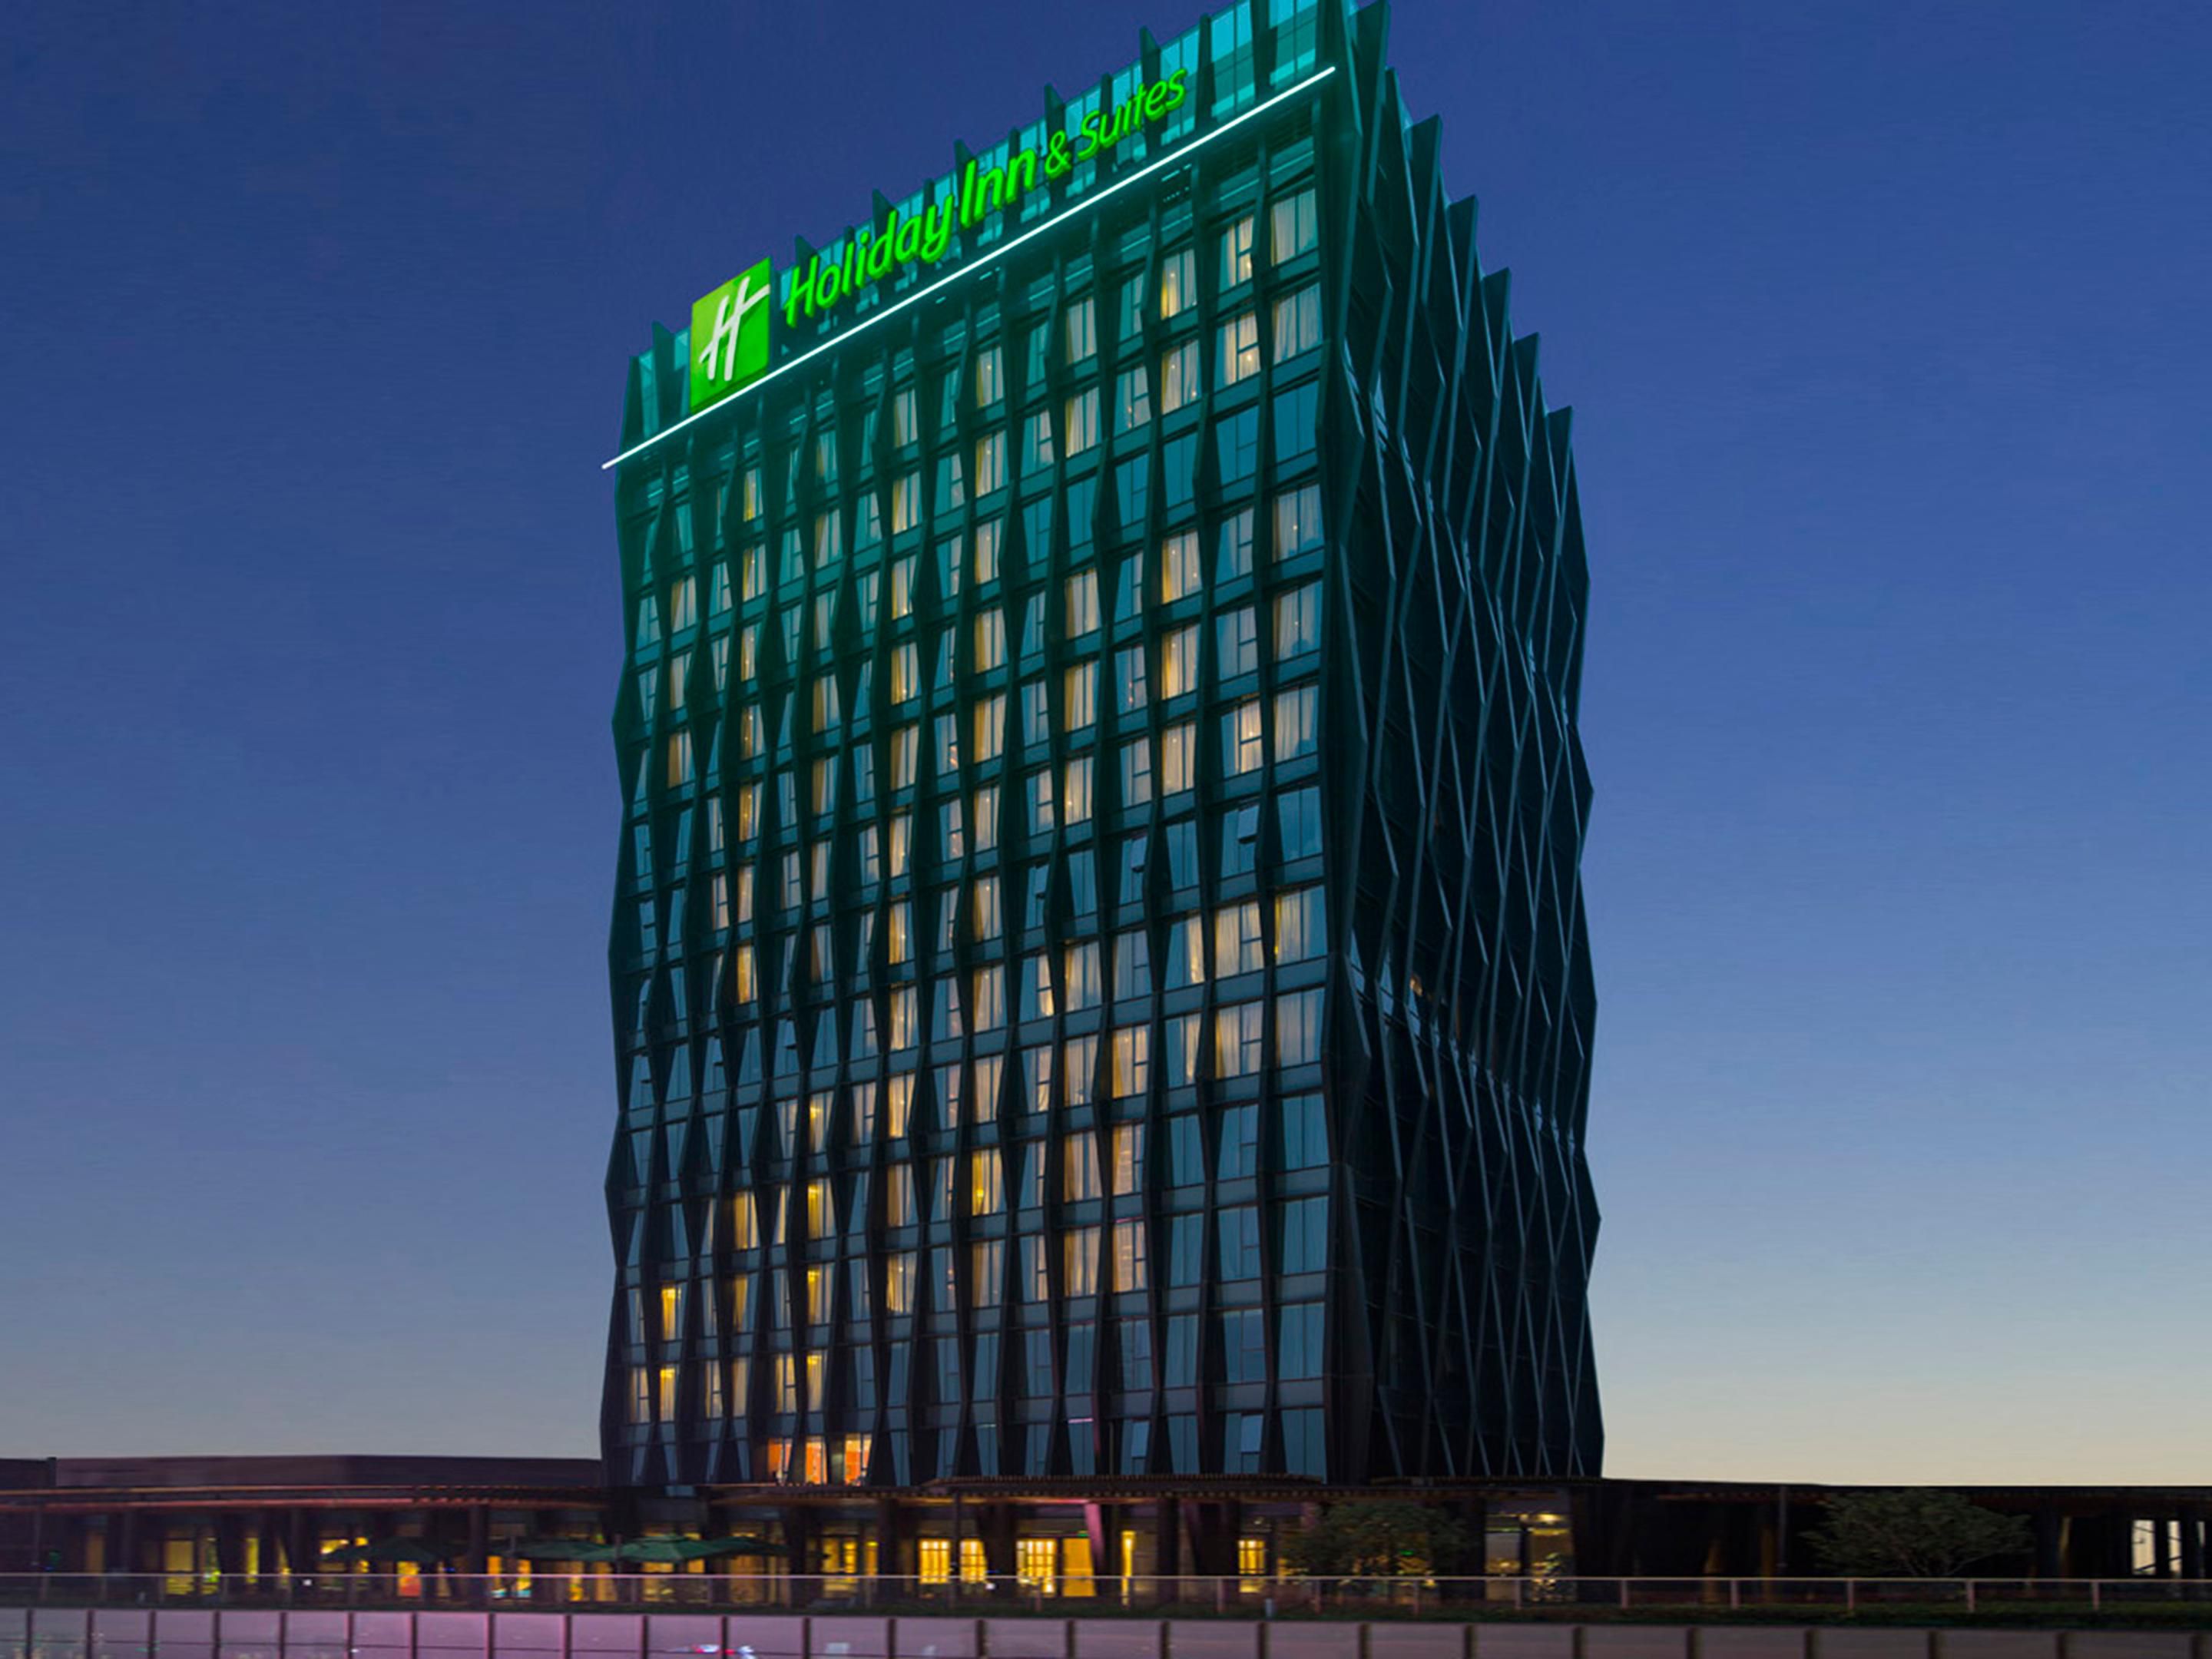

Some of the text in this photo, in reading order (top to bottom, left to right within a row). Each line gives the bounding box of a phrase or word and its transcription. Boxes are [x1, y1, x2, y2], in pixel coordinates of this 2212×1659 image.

[783, 68, 1186, 327] Holiday Inn & Suites
